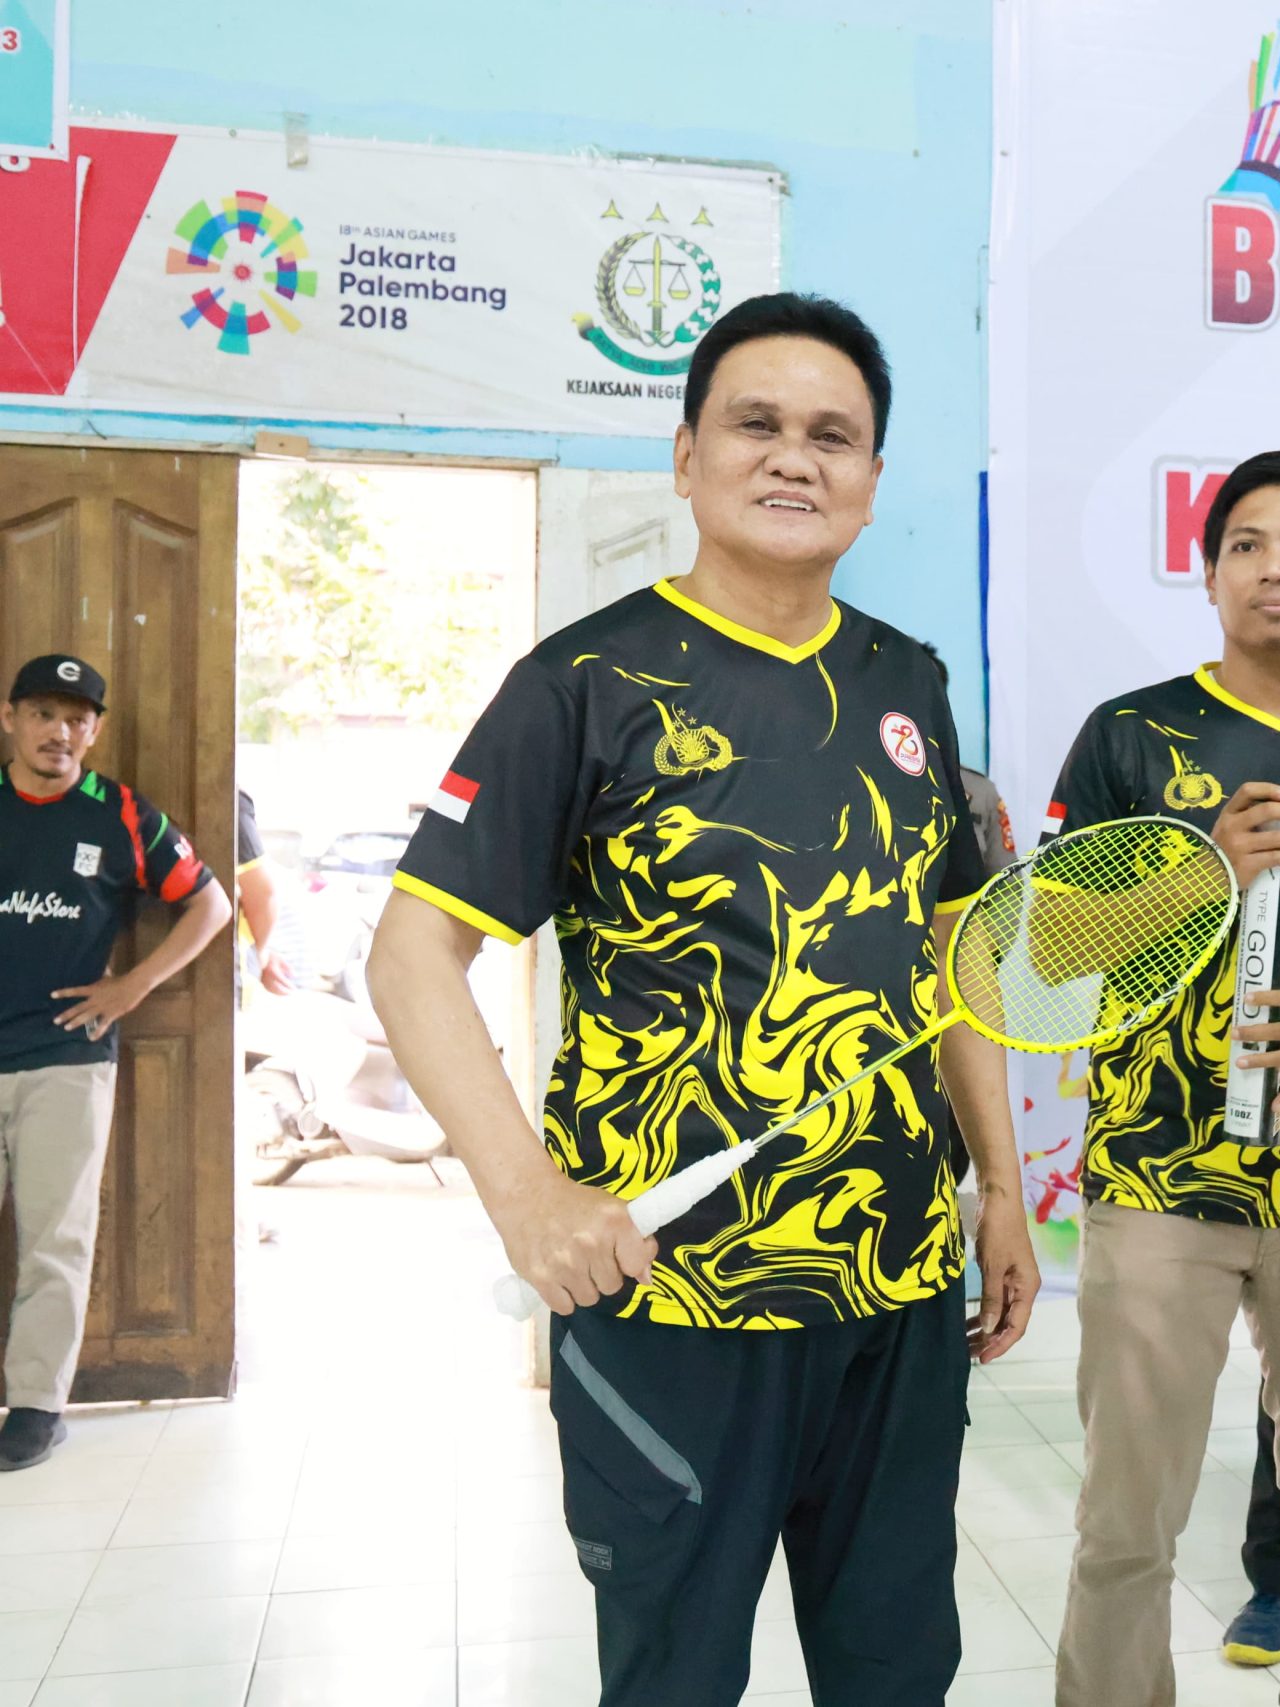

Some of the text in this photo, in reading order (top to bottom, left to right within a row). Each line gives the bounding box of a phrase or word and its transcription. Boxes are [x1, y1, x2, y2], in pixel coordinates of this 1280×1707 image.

[363, 226, 405, 240] ASIAN
[407, 229, 456, 243] GAMES
[339, 243, 456, 272] Jakarta
[339, 272, 507, 311] Palembang
[339, 304, 408, 330] 2018
[566, 379, 688, 400] KEJAKSAAN NEGE
[1257, 890, 1268, 922] TYPE
[1242, 930, 1267, 1018] GOLD
